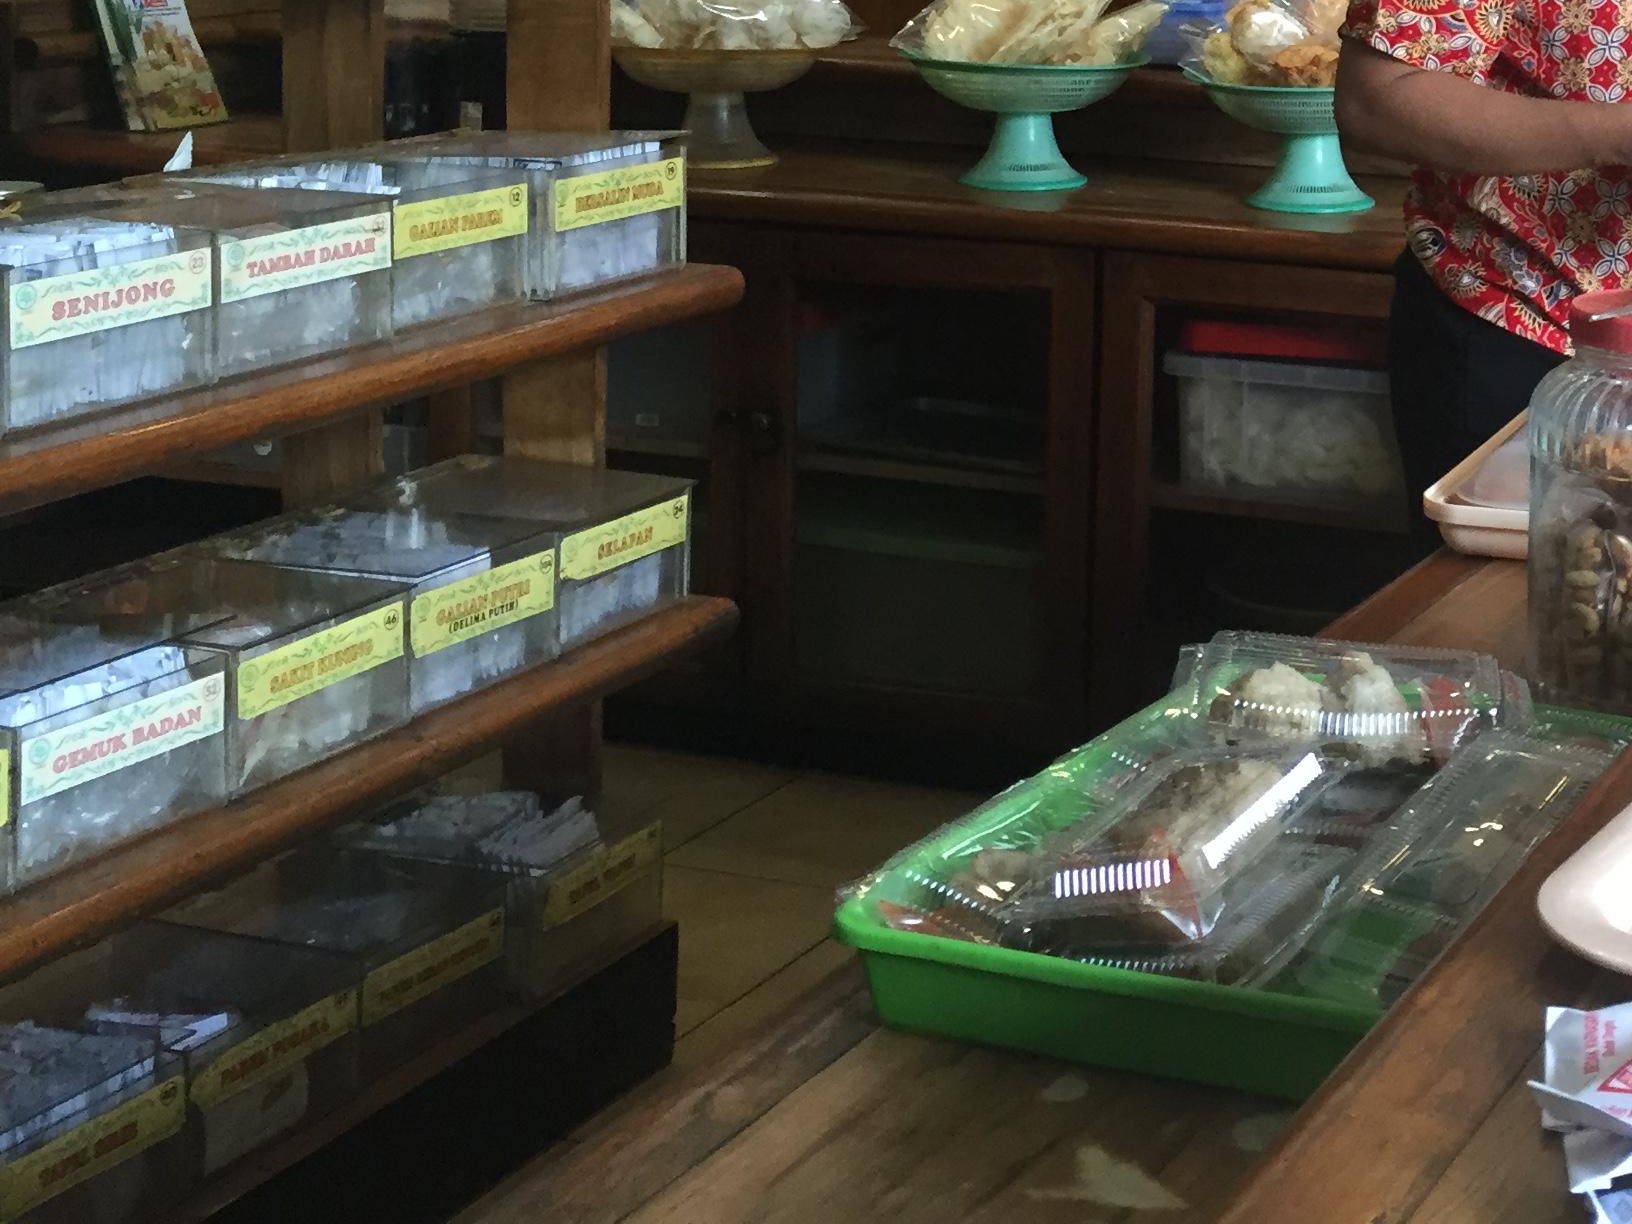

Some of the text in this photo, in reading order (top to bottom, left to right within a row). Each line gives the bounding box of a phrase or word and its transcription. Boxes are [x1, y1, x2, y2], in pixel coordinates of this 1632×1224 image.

[409, 217, 459, 242] GALIAN
[246, 238, 376, 278] TAMBAH DARAH
[52, 279, 176, 321] SENIJONG
[270, 663, 314, 693] SAKIT
[53, 706, 202, 773] GEMUK BADAN
